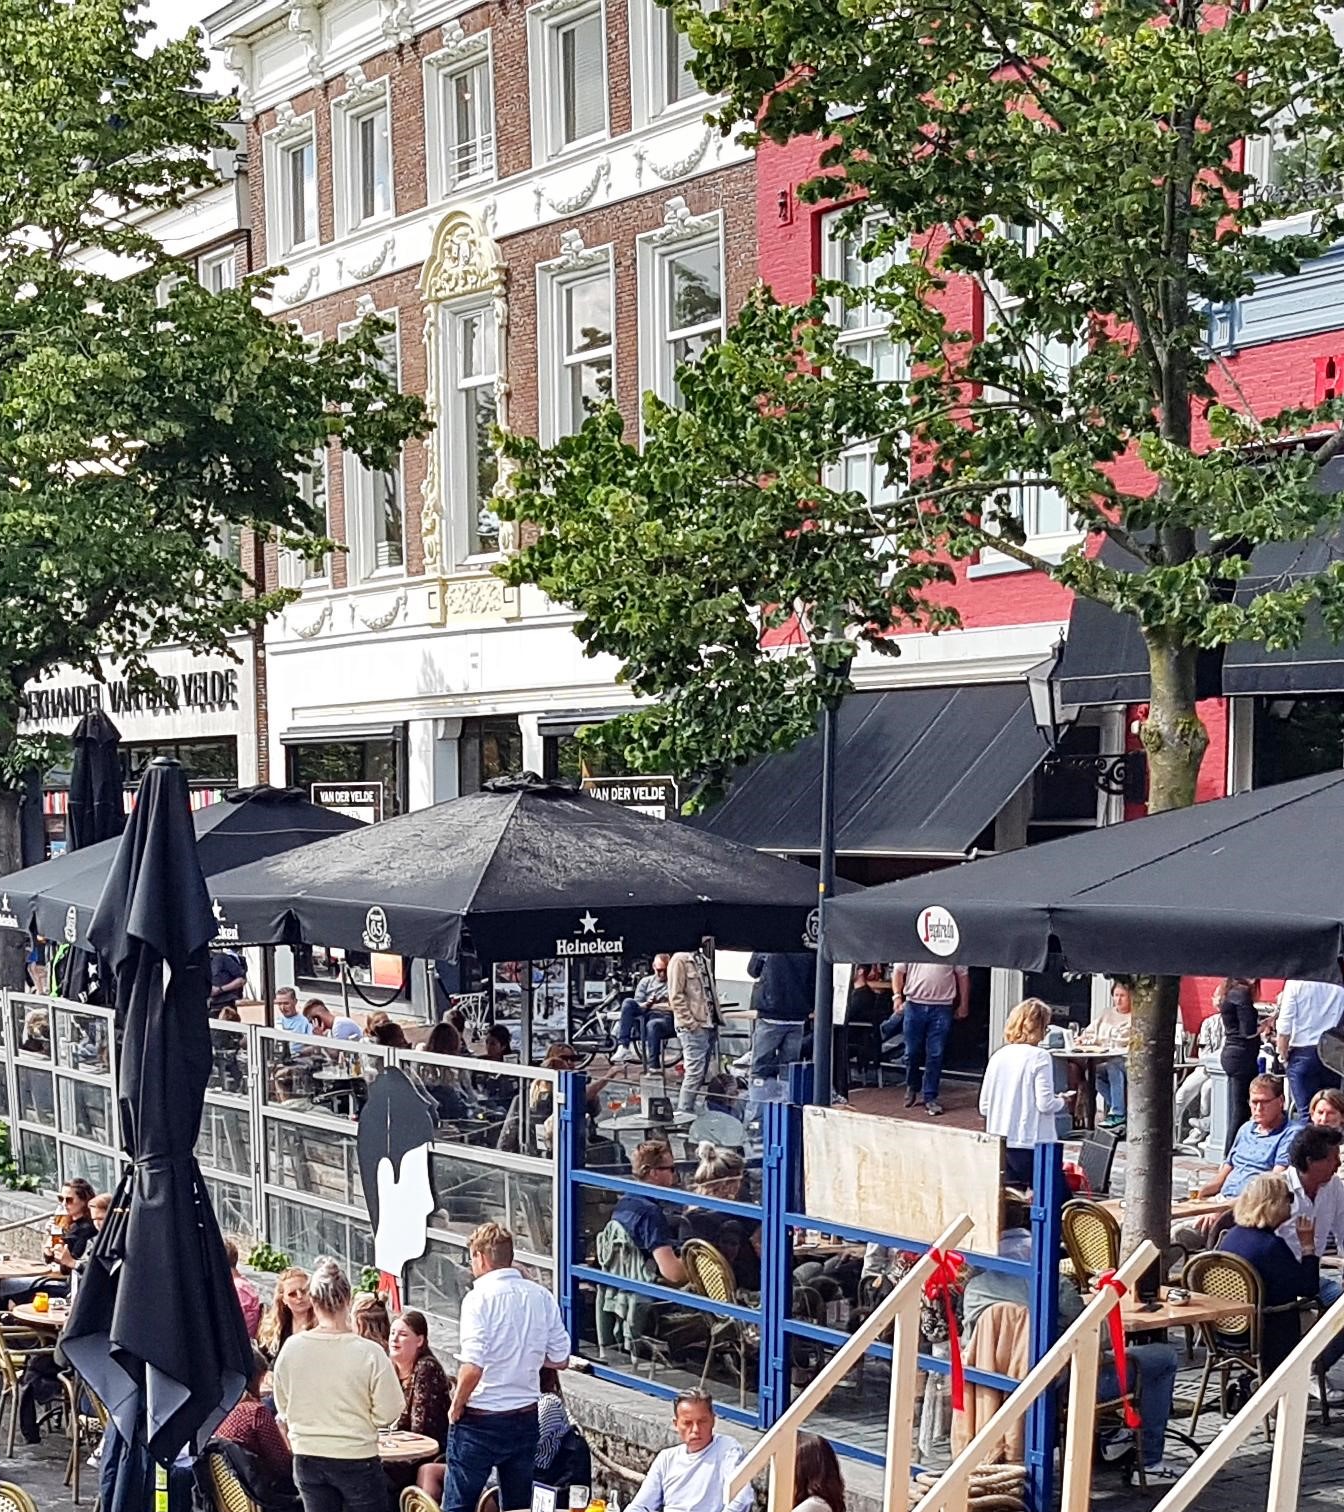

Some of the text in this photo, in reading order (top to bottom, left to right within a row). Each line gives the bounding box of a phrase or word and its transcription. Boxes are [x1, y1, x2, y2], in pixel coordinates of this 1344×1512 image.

[181, 669, 237, 708] VELDE
[320, 790, 375, 802] VAN DER VELDE
[589, 786, 665, 800] VAN DER VELDE
[556, 937, 623, 956] Heineken
